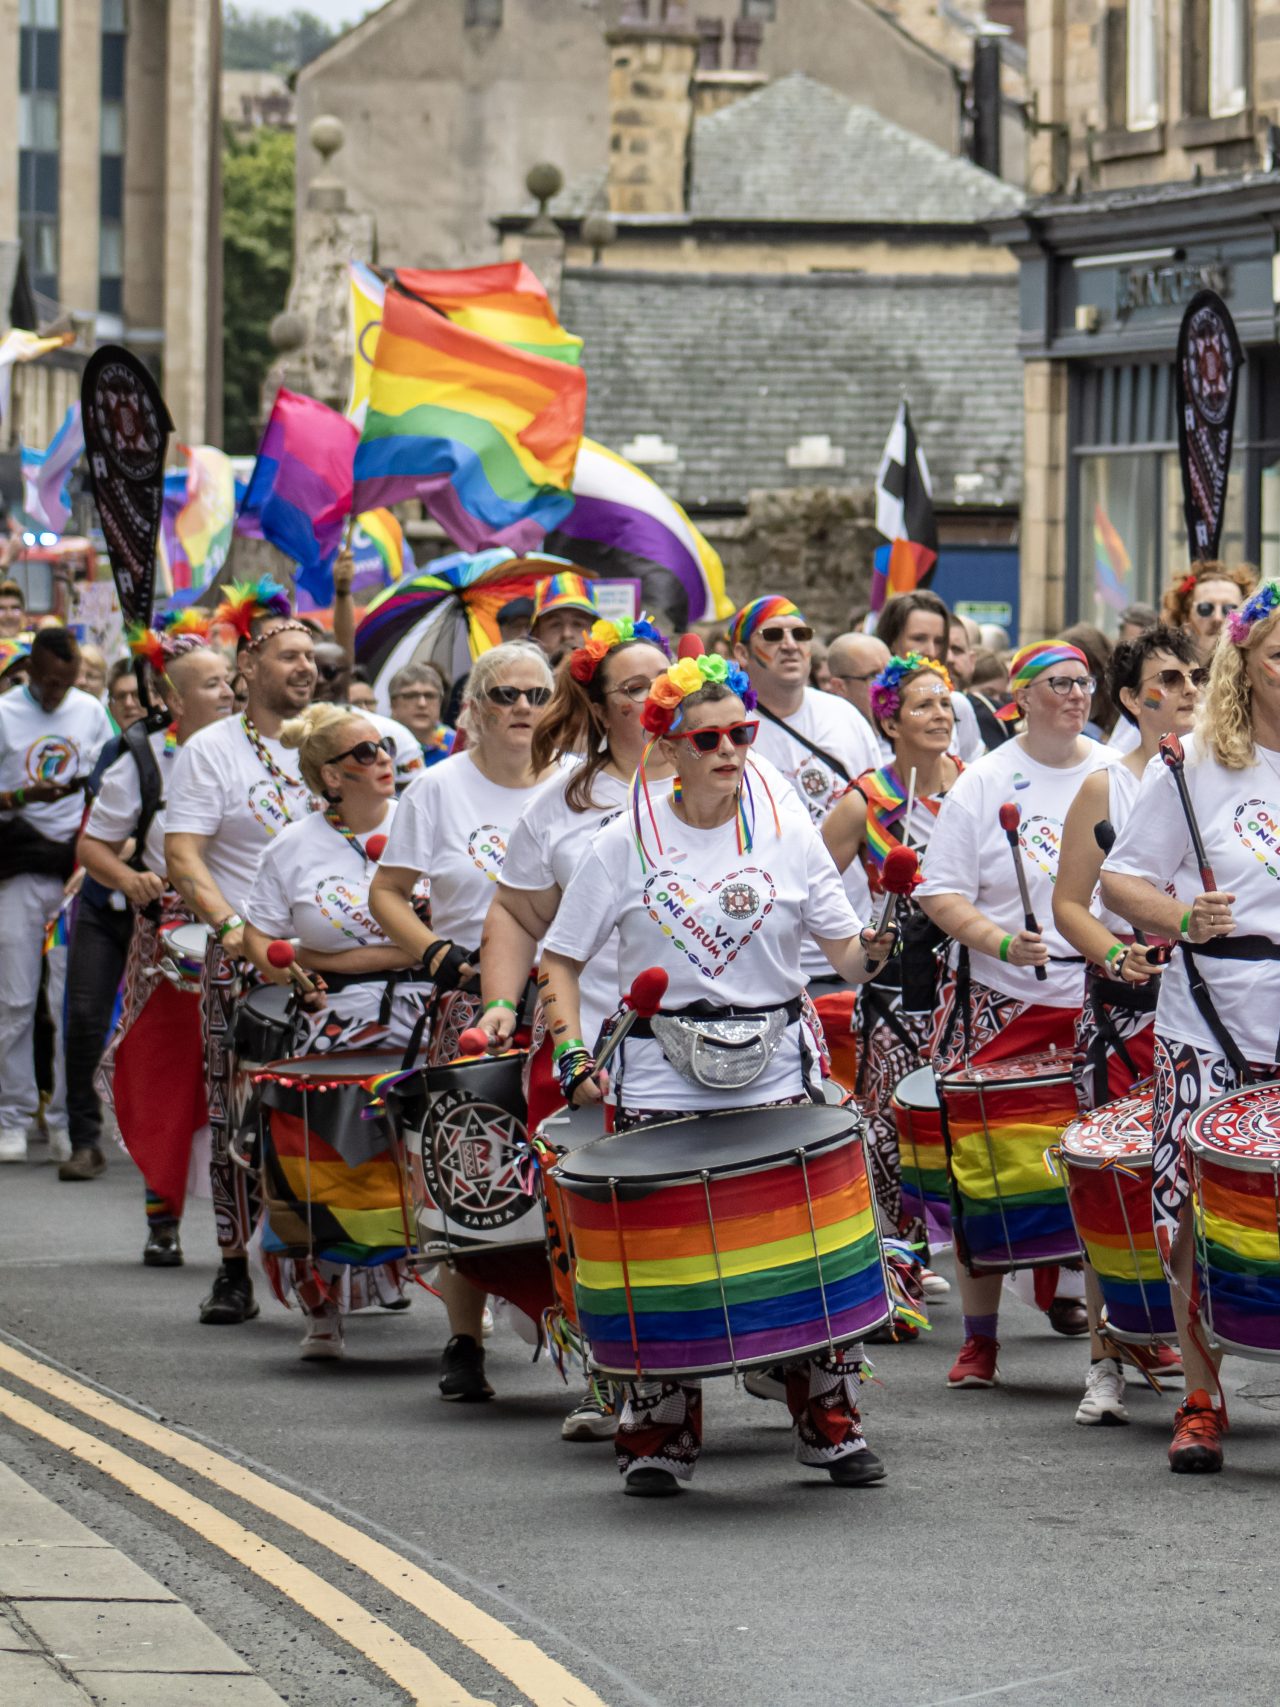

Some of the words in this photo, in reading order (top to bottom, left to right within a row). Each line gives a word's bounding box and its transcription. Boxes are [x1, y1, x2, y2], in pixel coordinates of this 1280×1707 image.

[260, 799, 283, 821] ONE
[1247, 821, 1277, 847] ONE
[1031, 835, 1058, 858] ONE
[327, 894, 351, 915] ONE
[336, 886, 361, 905] ONE
[656, 892, 685, 919] ONE
[682, 916, 721, 959] DRUM
[667, 882, 696, 906] ONE
[693, 903, 735, 949] LOVE
[424, 1136, 439, 1192] BANDA
[464, 1209, 516, 1226] SAMBA
